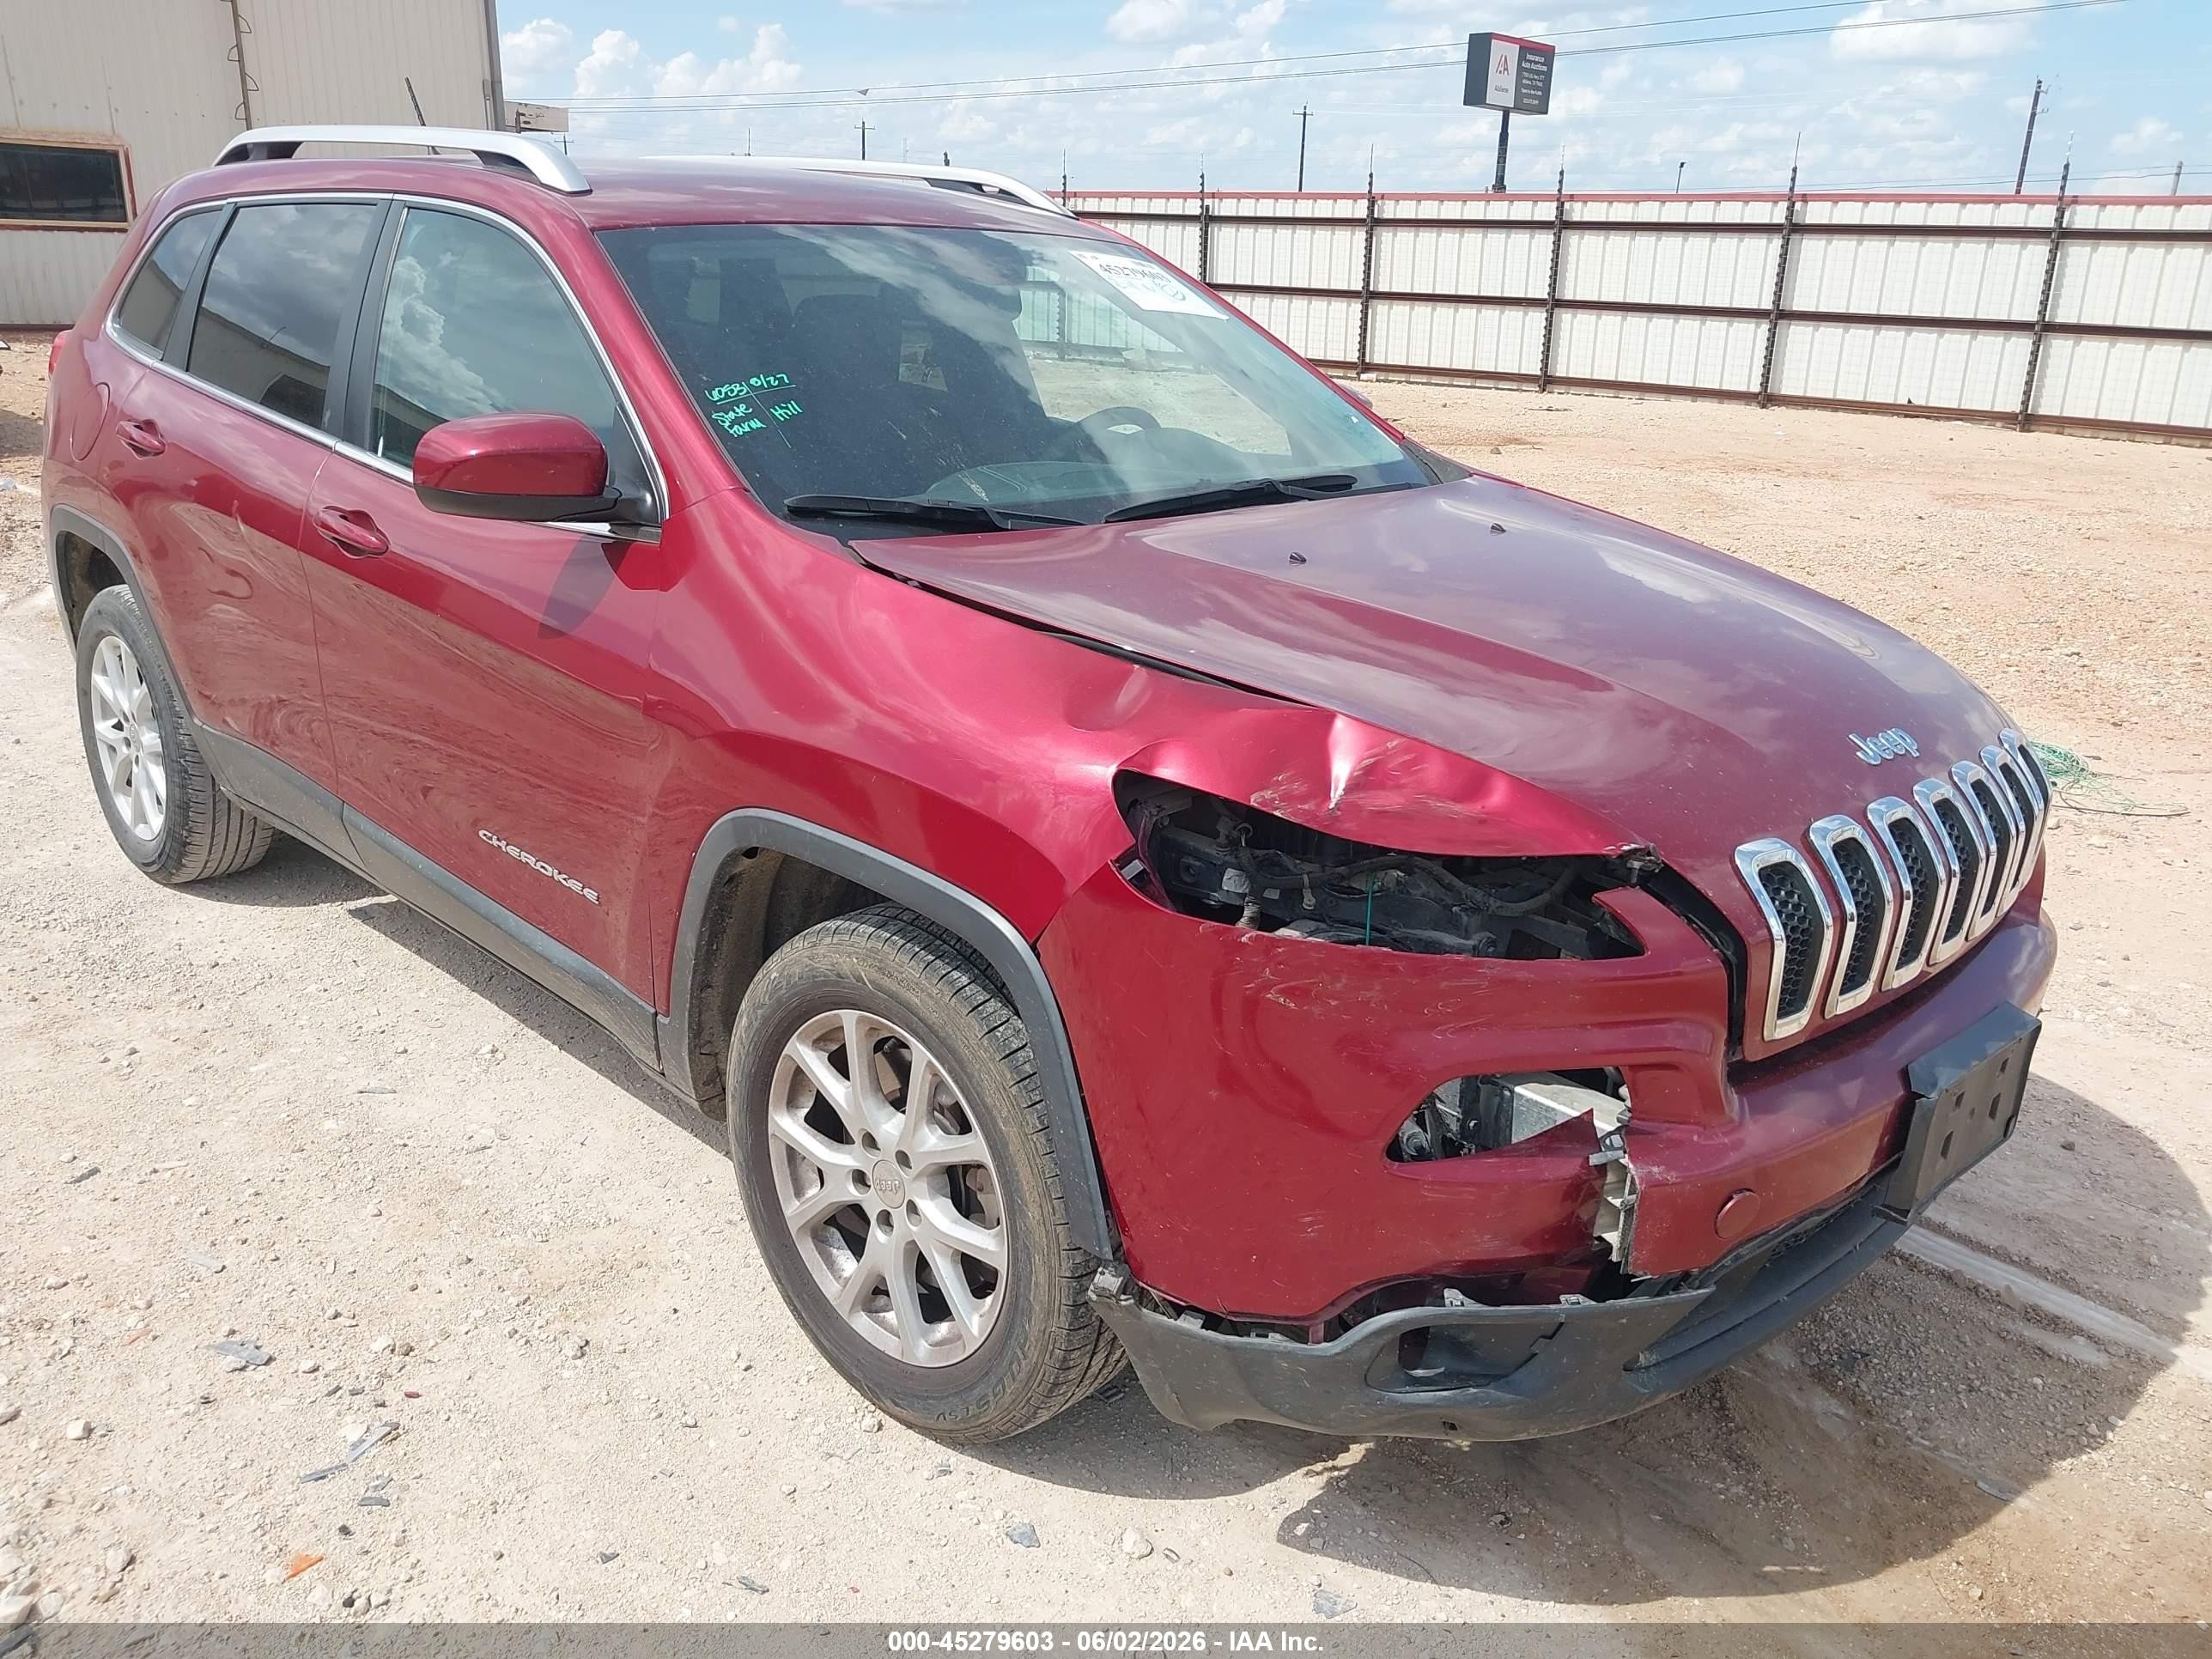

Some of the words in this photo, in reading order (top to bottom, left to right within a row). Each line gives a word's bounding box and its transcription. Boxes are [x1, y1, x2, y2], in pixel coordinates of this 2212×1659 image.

[769, 400, 803, 421] Hill
[1848, 727, 1920, 765] Jeep
[478, 830, 600, 905] CHEROKEE
